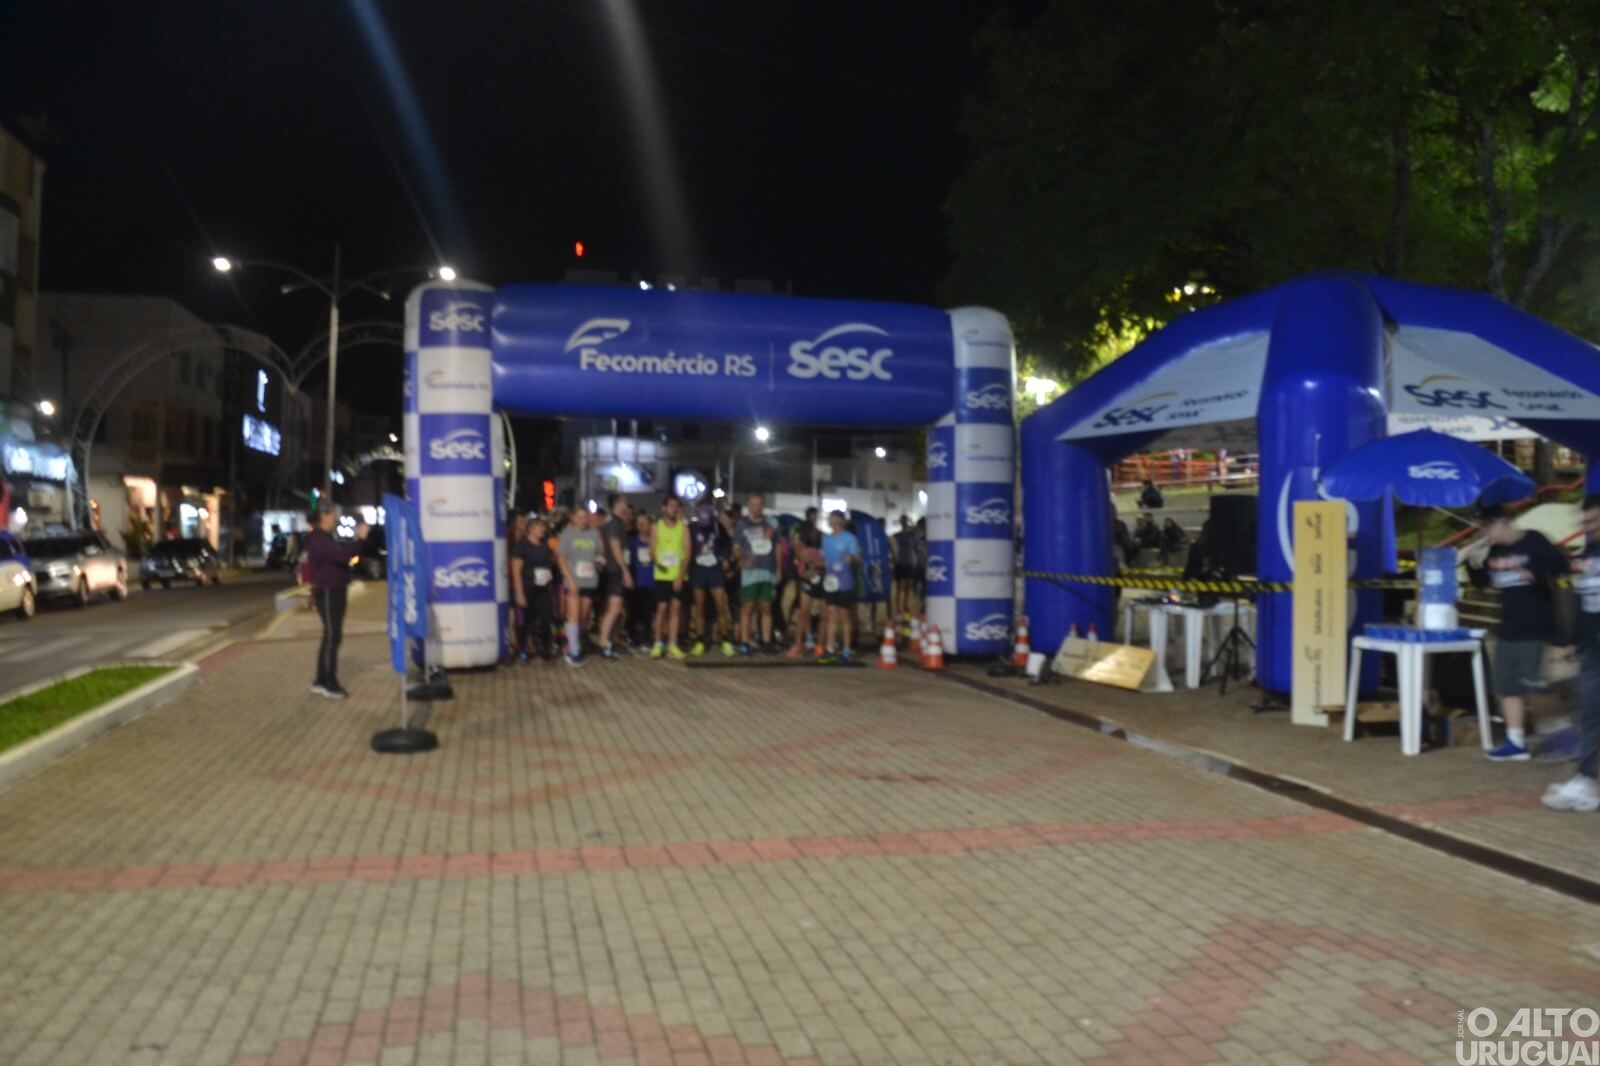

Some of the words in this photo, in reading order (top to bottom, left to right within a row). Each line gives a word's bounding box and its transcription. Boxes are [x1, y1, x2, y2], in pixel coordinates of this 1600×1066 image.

[429, 311, 484, 332] Sesc
[579, 348, 718, 376] Fecomércio
[725, 354, 757, 377] RS
[787, 340, 894, 380] Sesc
[430, 438, 485, 460] Sesc
[434, 566, 490, 588] Sesc
